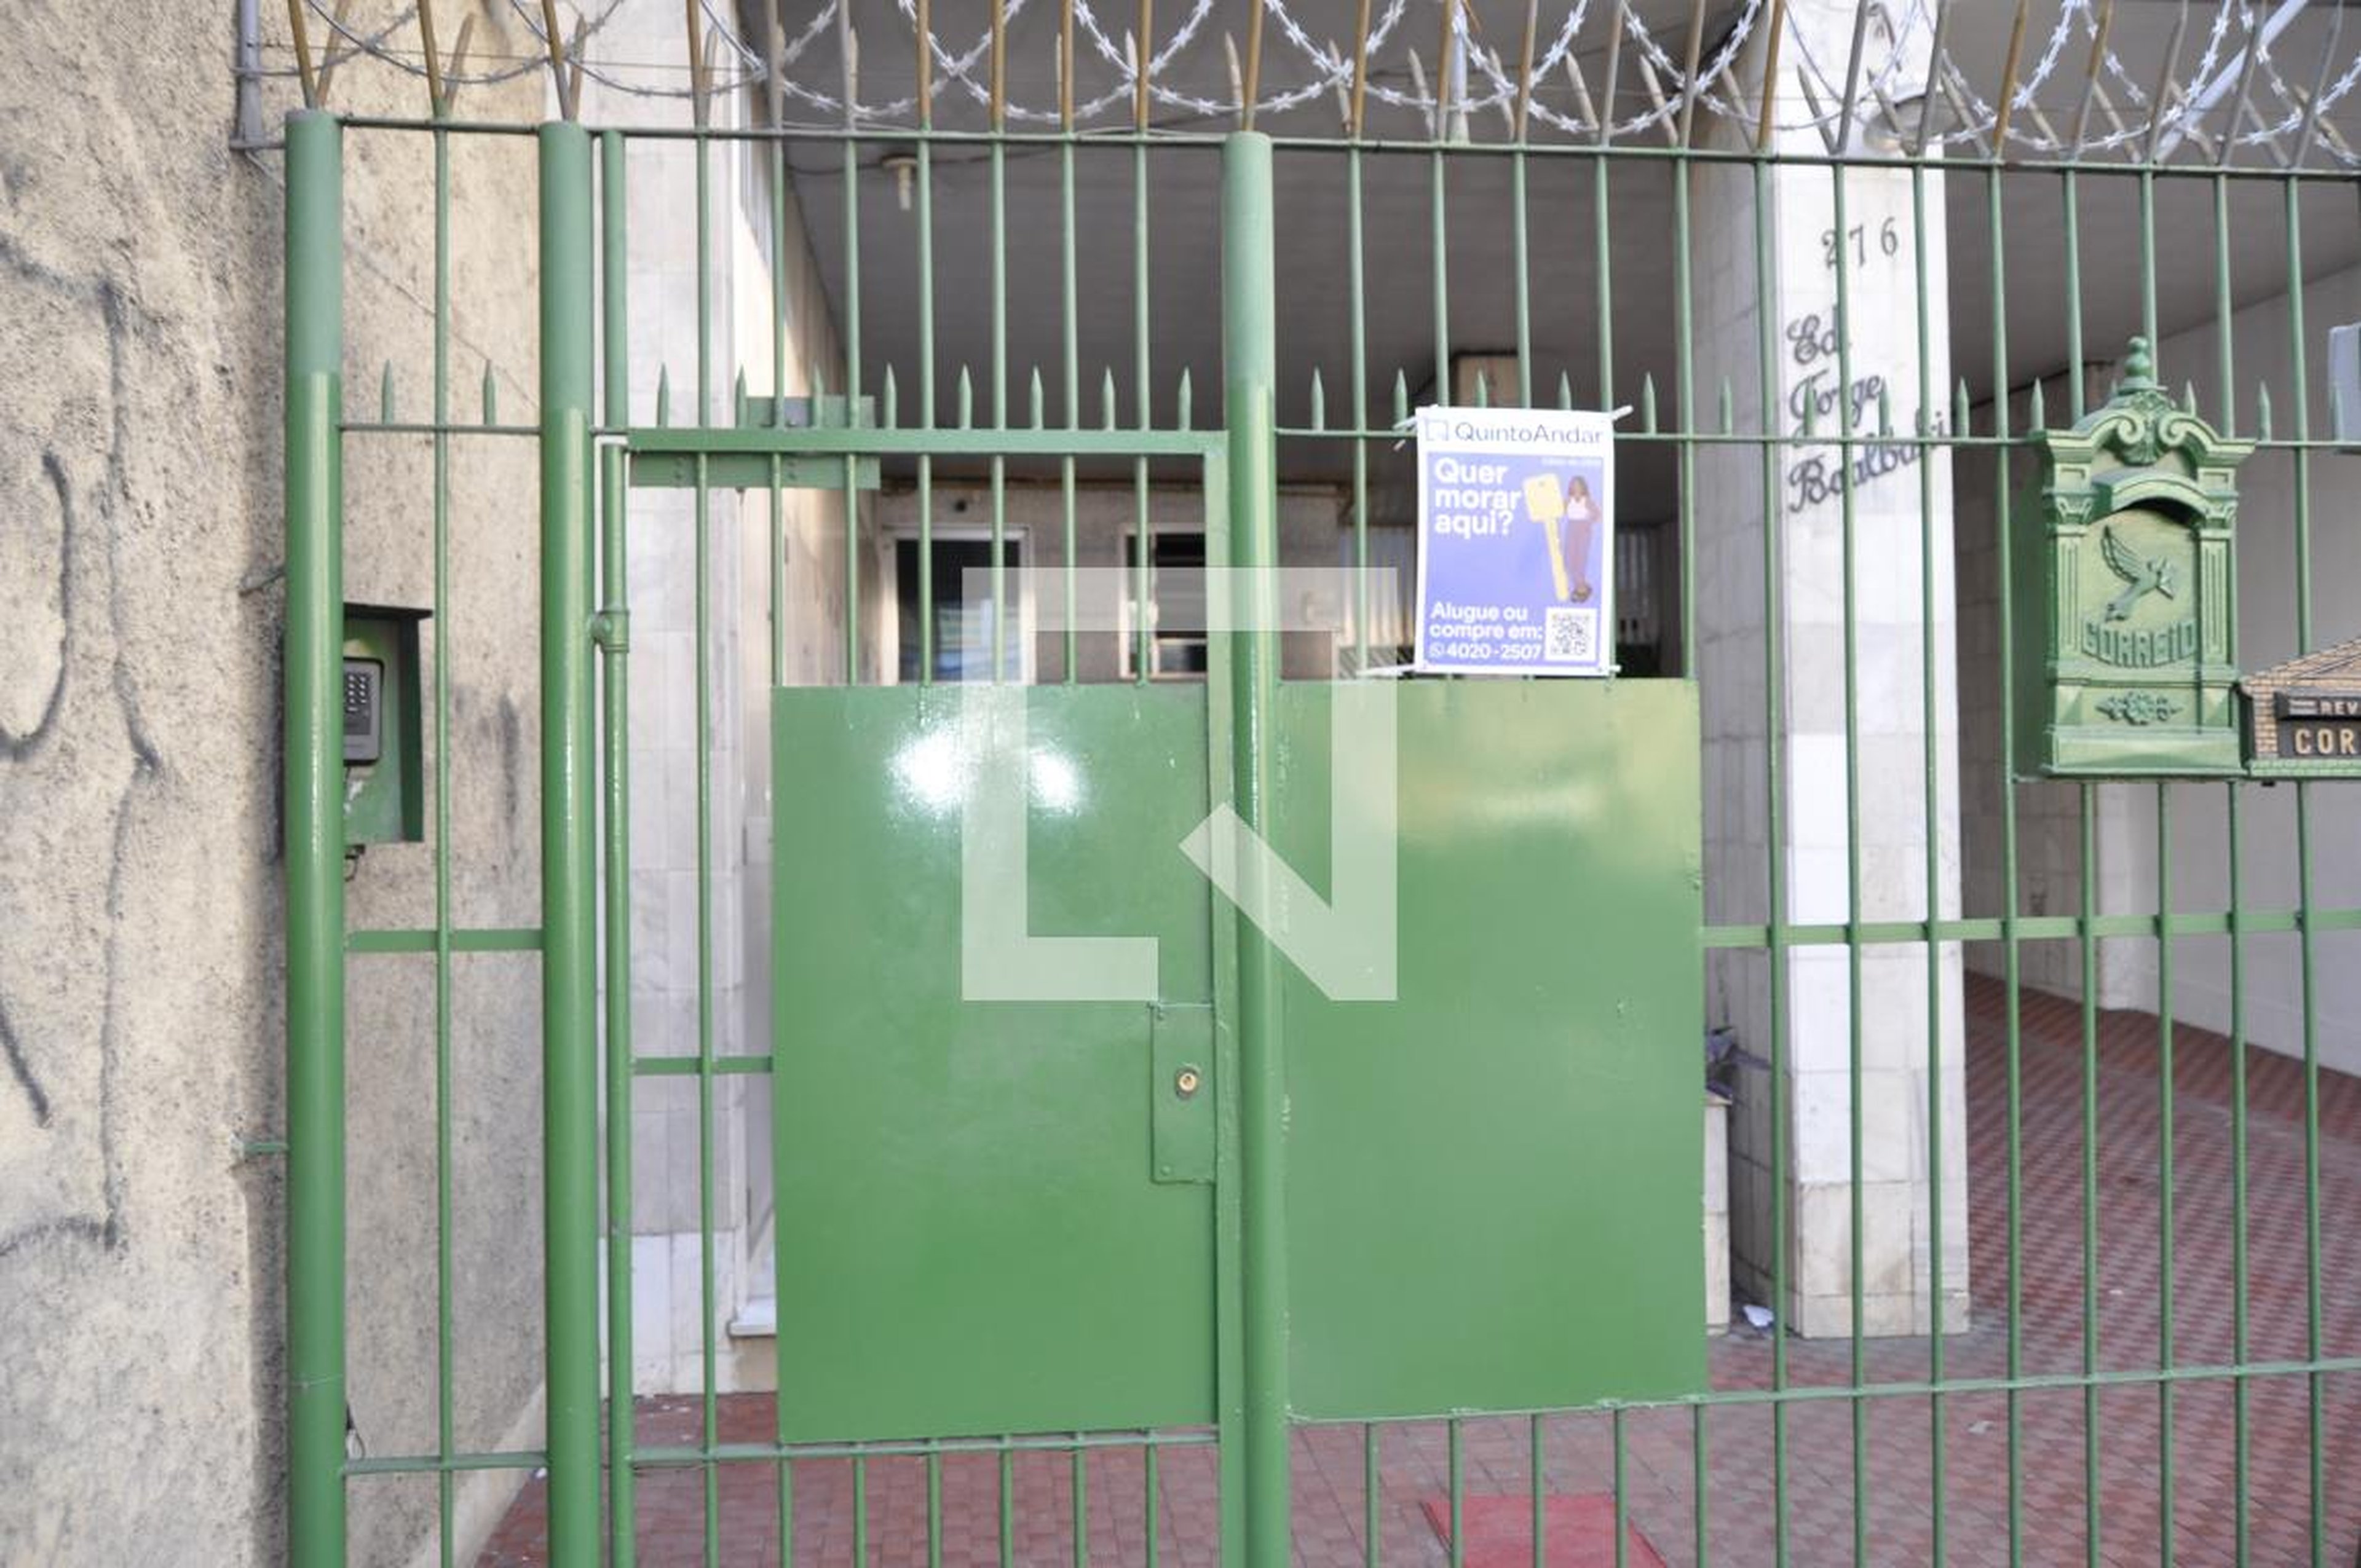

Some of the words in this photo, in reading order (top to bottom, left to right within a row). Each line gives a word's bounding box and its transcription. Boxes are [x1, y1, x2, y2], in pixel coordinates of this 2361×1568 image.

[1821, 216, 1898, 269] 276
[1455, 422, 1603, 443] QuintoAndar
[1435, 457, 1508, 484] Quer
[1435, 487, 1522, 510] morar
[1435, 510, 1514, 540] aqui?
[1430, 601, 1499, 623] Alugue
[1503, 606, 1528, 621] ou
[1430, 624, 1504, 641] compre
[1508, 626, 1543, 639] em:
[2082, 618, 2197, 668] CORREIO
[2320, 701, 2358, 715] REV
[2295, 729, 2357, 754] COR
